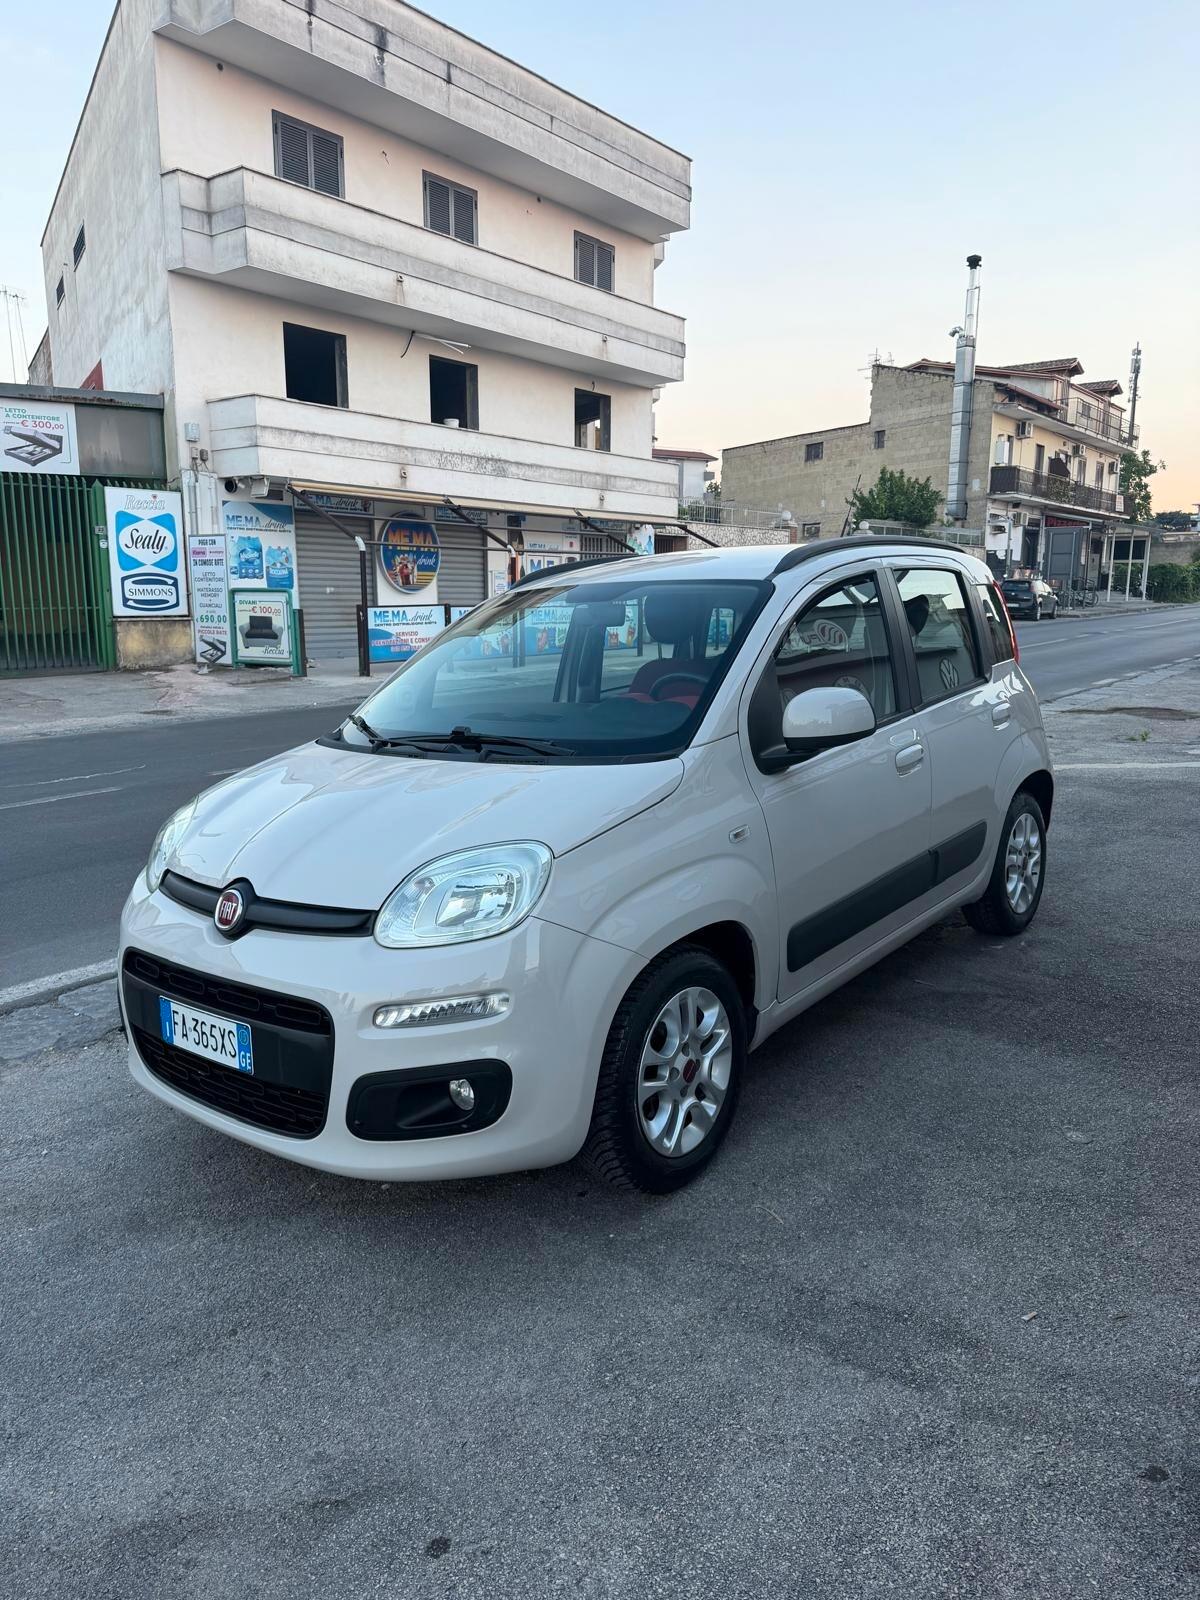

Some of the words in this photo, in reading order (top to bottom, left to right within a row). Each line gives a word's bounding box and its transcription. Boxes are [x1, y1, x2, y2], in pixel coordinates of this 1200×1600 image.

[12, 413, 60, 422] CONTENITORE
[32, 420, 64, 430] 300,00
[125, 528, 167, 555] Sealy
[416, 553, 436, 567] drink
[128, 588, 174, 597] SIMMONS
[220, 900, 237, 920] FIAT
[240, 1050, 252, 1071] GE
